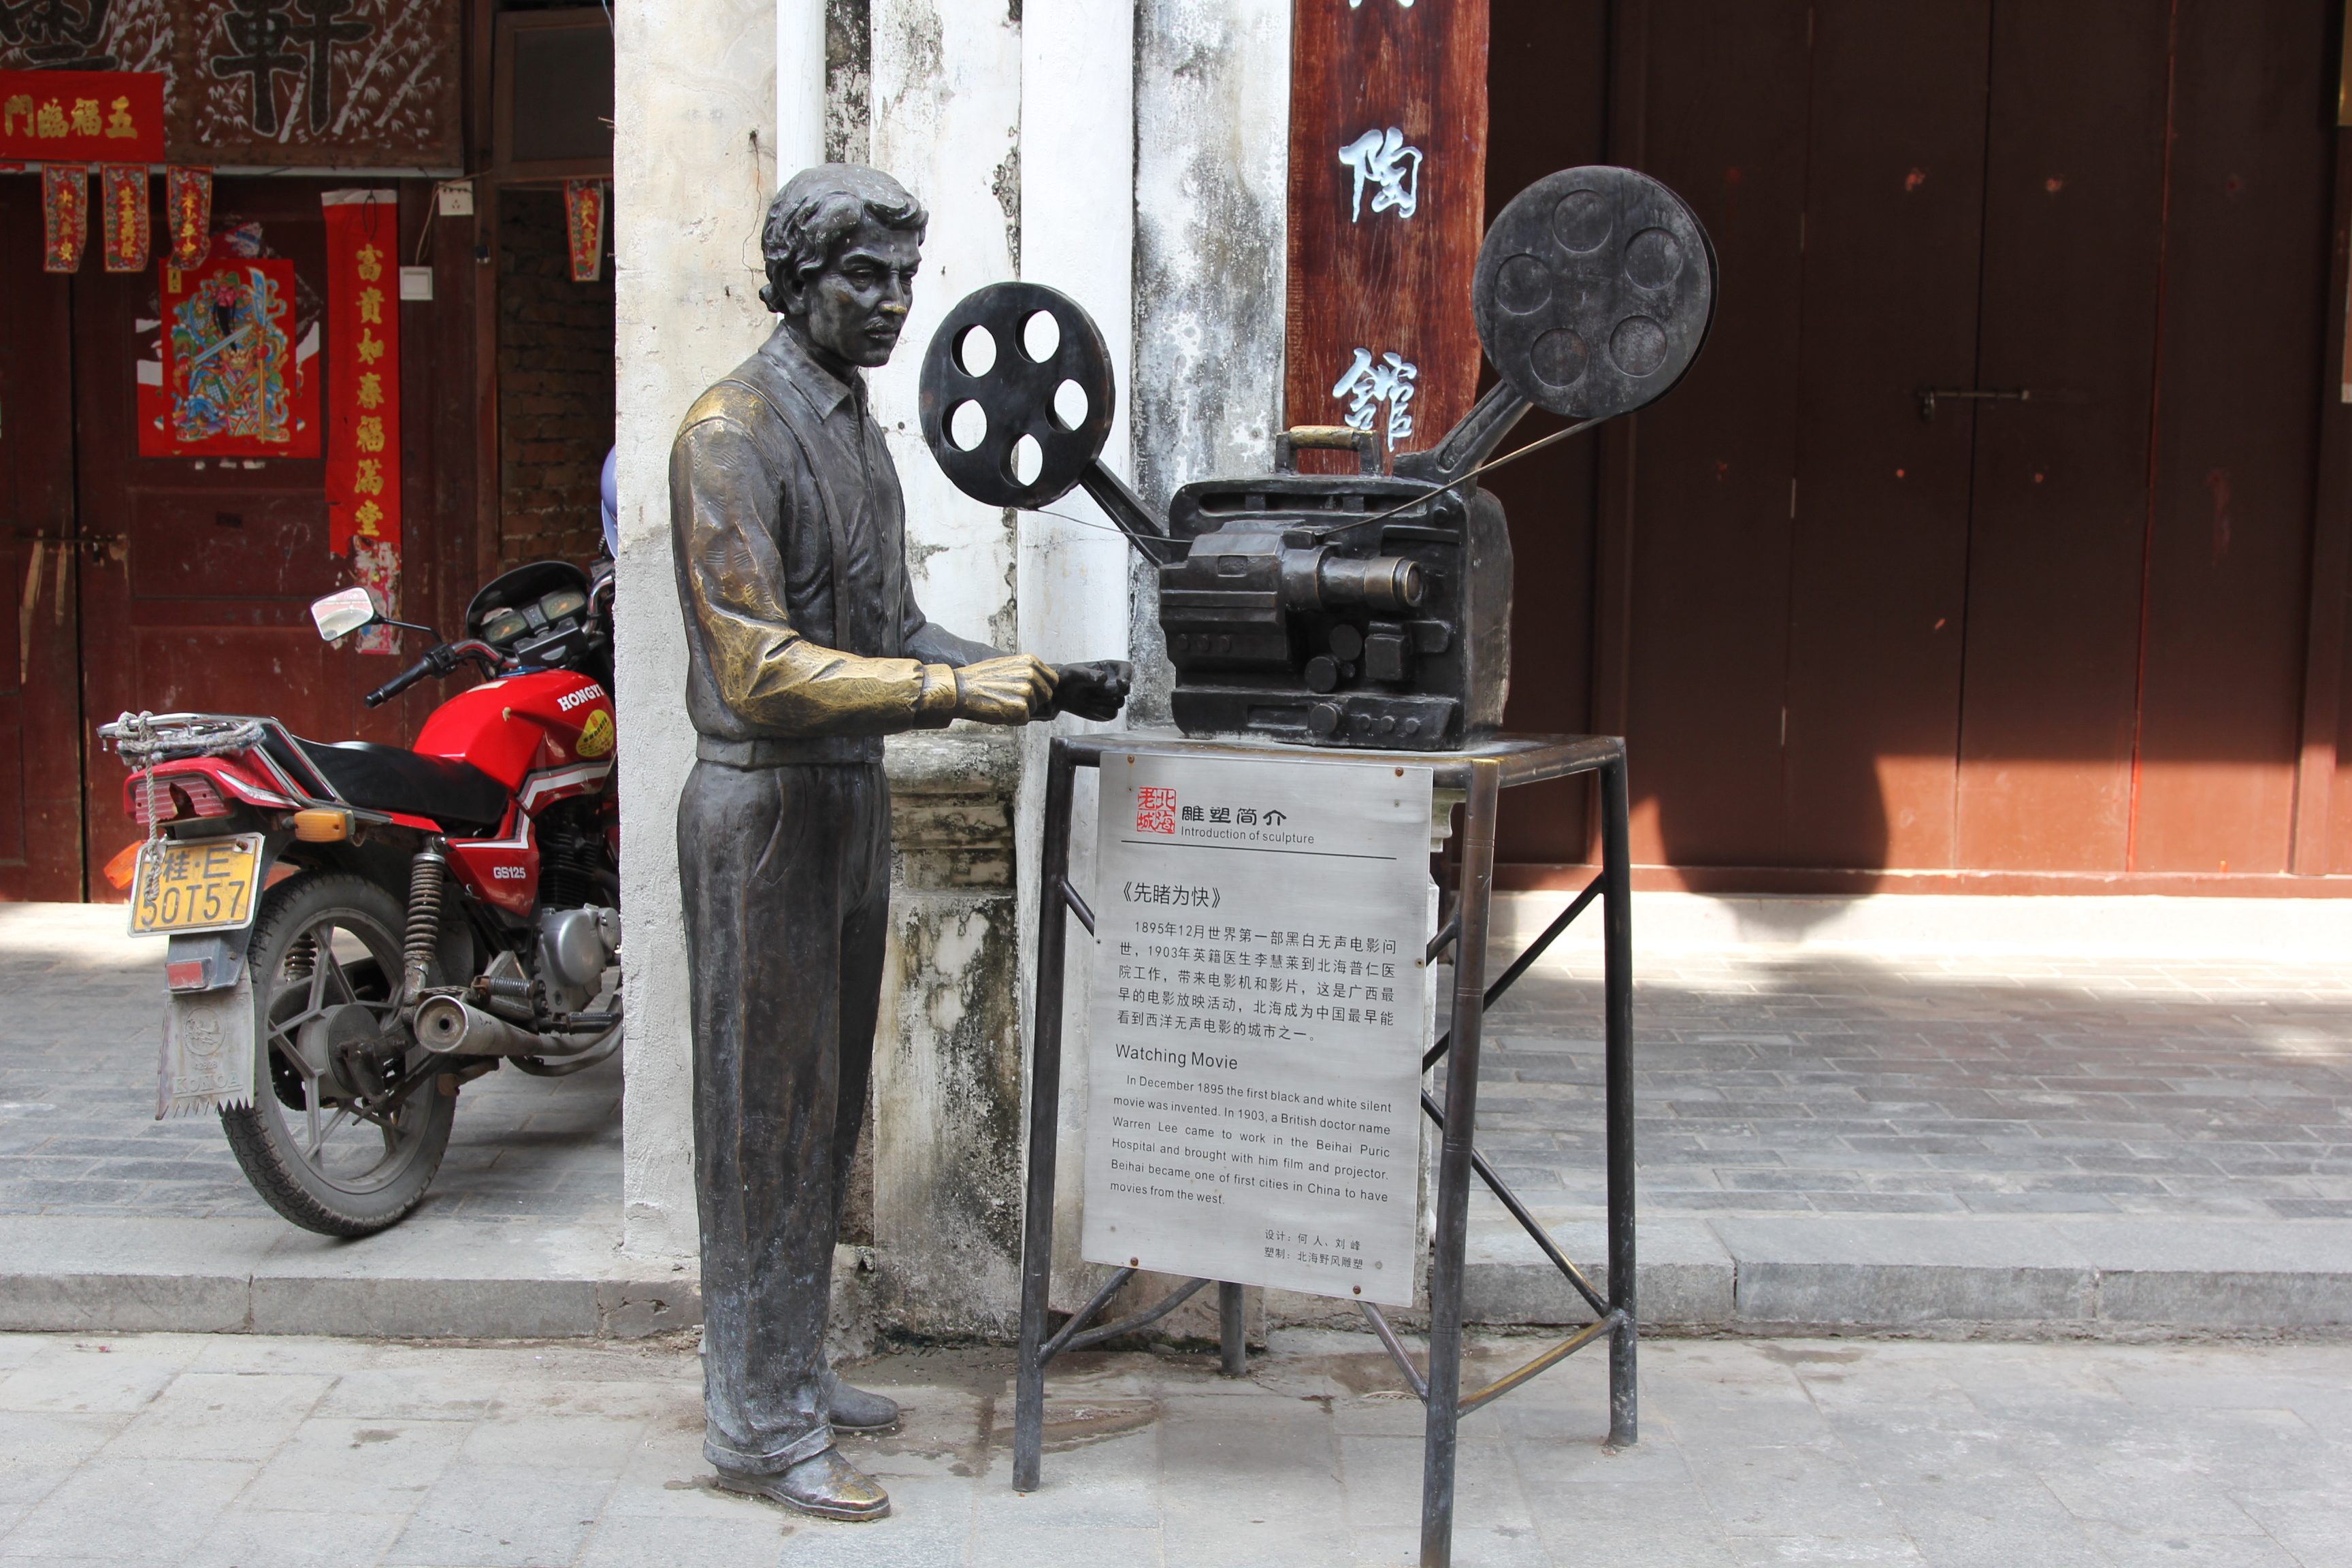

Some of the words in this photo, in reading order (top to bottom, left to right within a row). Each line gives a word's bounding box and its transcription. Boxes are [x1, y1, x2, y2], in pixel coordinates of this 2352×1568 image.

[1180, 825, 1246, 840] Introduction
[1248, 829, 1260, 840] of
[1262, 831, 1314, 845] sculpture
[493, 866, 527, 879] GS125
[1115, 1043, 1186, 1068] Watching
[1190, 1050, 1238, 1070] Movie
[1126, 1074, 1137, 1085] In
[1139, 1075, 1194, 1092] December
[1197, 1081, 1224, 1095] 1895
[1226, 1085, 1243, 1097] the
[1245, 1086, 1268, 1100] first
[1270, 1089, 1301, 1103] black
[1302, 1094, 1324, 1106] and
[1326, 1096, 1357, 1109] white
[1359, 1100, 1392, 1113] silent
[1113, 1096, 1145, 1108] movie
[1147, 1100, 1169, 1111] was
[1171, 1102, 1221, 1116] invented.
[1224, 1106, 1235, 1118] In
[1237, 1108, 1268, 1124] 1903,
[1270, 1113, 1277, 1123] a
[1280, 1112, 1317, 1127] British
[1319, 1117, 1356, 1131] doctor
[1358, 1123, 1390, 1135] name
[1112, 1115, 1151, 1130] Warren
[1158, 1120, 1178, 1133] Lee
[1184, 1126, 1214, 1138] came
[1221, 1128, 1232, 1140] to
[1239, 1132, 1266, 1144] work
[1273, 1136, 1283, 1145] in
[1290, 1136, 1309, 1149] the
[1316, 1138, 1352, 1154] Beihai
[1359, 1143, 1390, 1158] Puric
[1111, 1137, 1155, 1152] Hospital
[1159, 1145, 1179, 1156] and
[1183, 1145, 1226, 1162] brought
[1230, 1152, 1253, 1164] with
[1258, 1154, 1278, 1167] him
[1282, 1156, 1303, 1170] film
[1307, 1162, 1329, 1173] and
[1334, 1165, 1388, 1180] projector.
[1109, 1182, 1147, 1195] movies
[1149, 1184, 1174, 1198] from
[1176, 1188, 1194, 1200] the
[1196, 1193, 1225, 1205] west.
[1110, 1158, 1144, 1173] Beihai
[1147, 1162, 1191, 1179] became
[1194, 1171, 1215, 1181] one
[1218, 1172, 1230, 1183] of
[1233, 1173, 1255, 1187] first
[1258, 1177, 1289, 1190] cities
[1292, 1183, 1303, 1192] in
[1307, 1182, 1340, 1196] China
[1344, 1187, 1356, 1198] to
[1360, 1188, 1388, 1203] have
